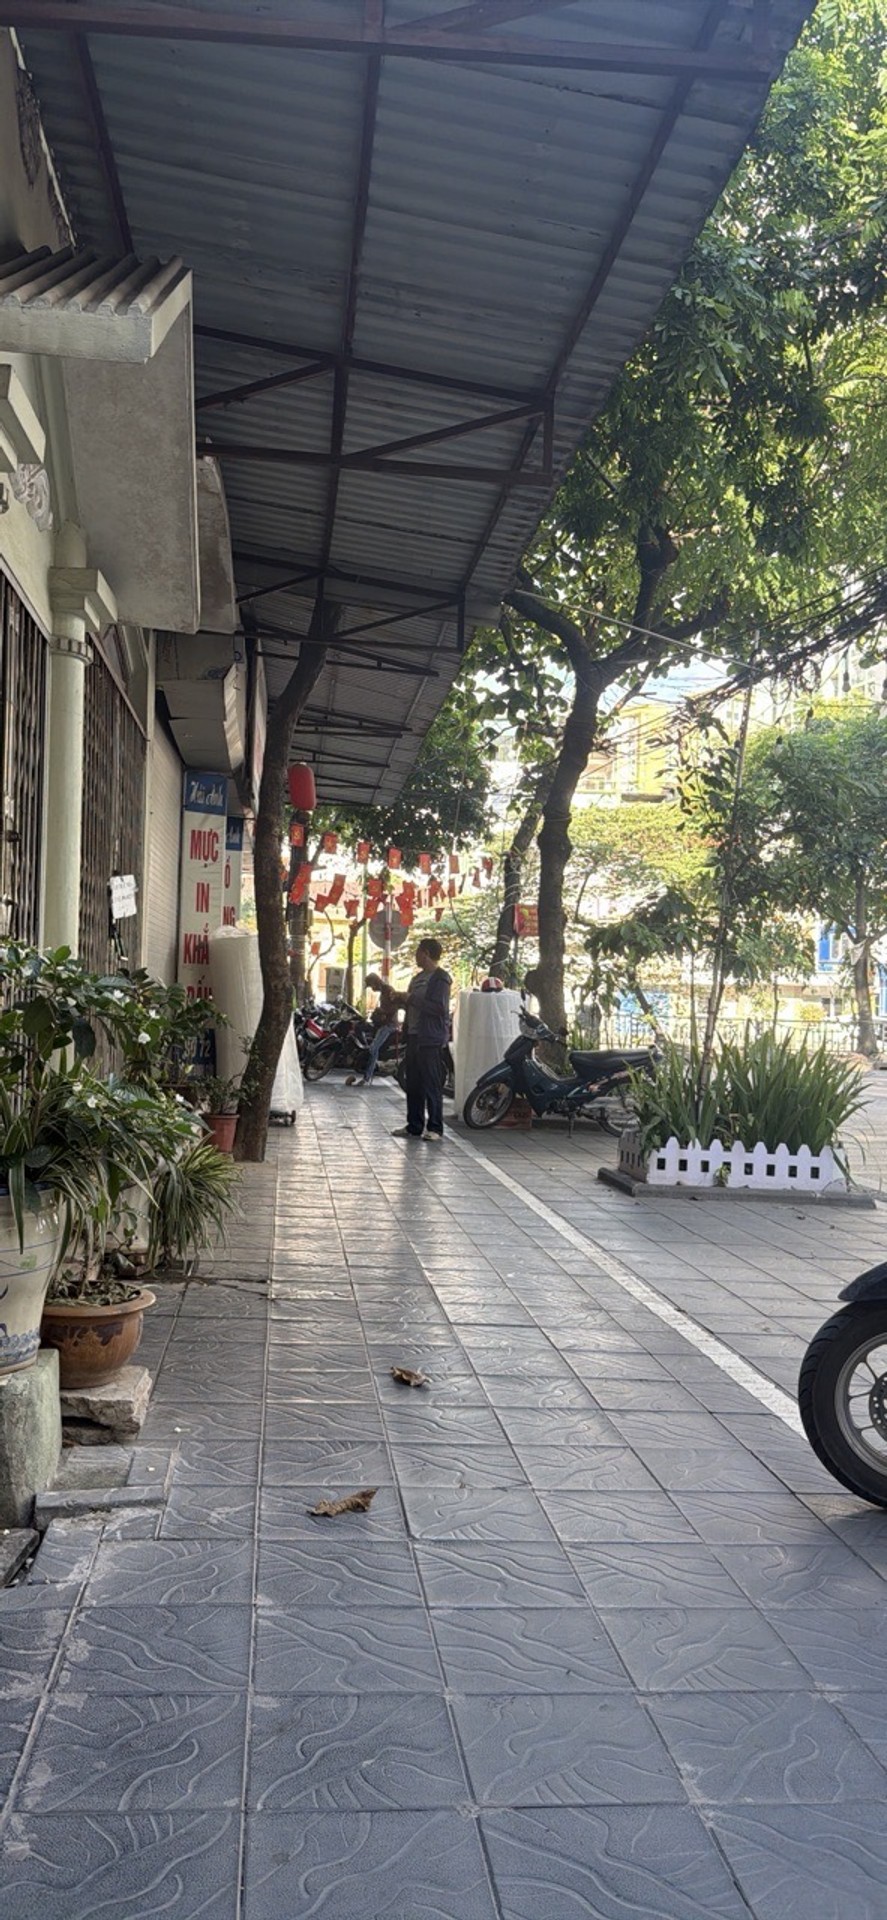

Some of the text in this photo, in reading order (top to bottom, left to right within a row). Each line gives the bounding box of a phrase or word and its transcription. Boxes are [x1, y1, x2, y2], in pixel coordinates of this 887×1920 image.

[190, 828, 219, 868] MỰC
[196, 882, 210, 913] IN
[184, 922, 210, 965] KHẮ
